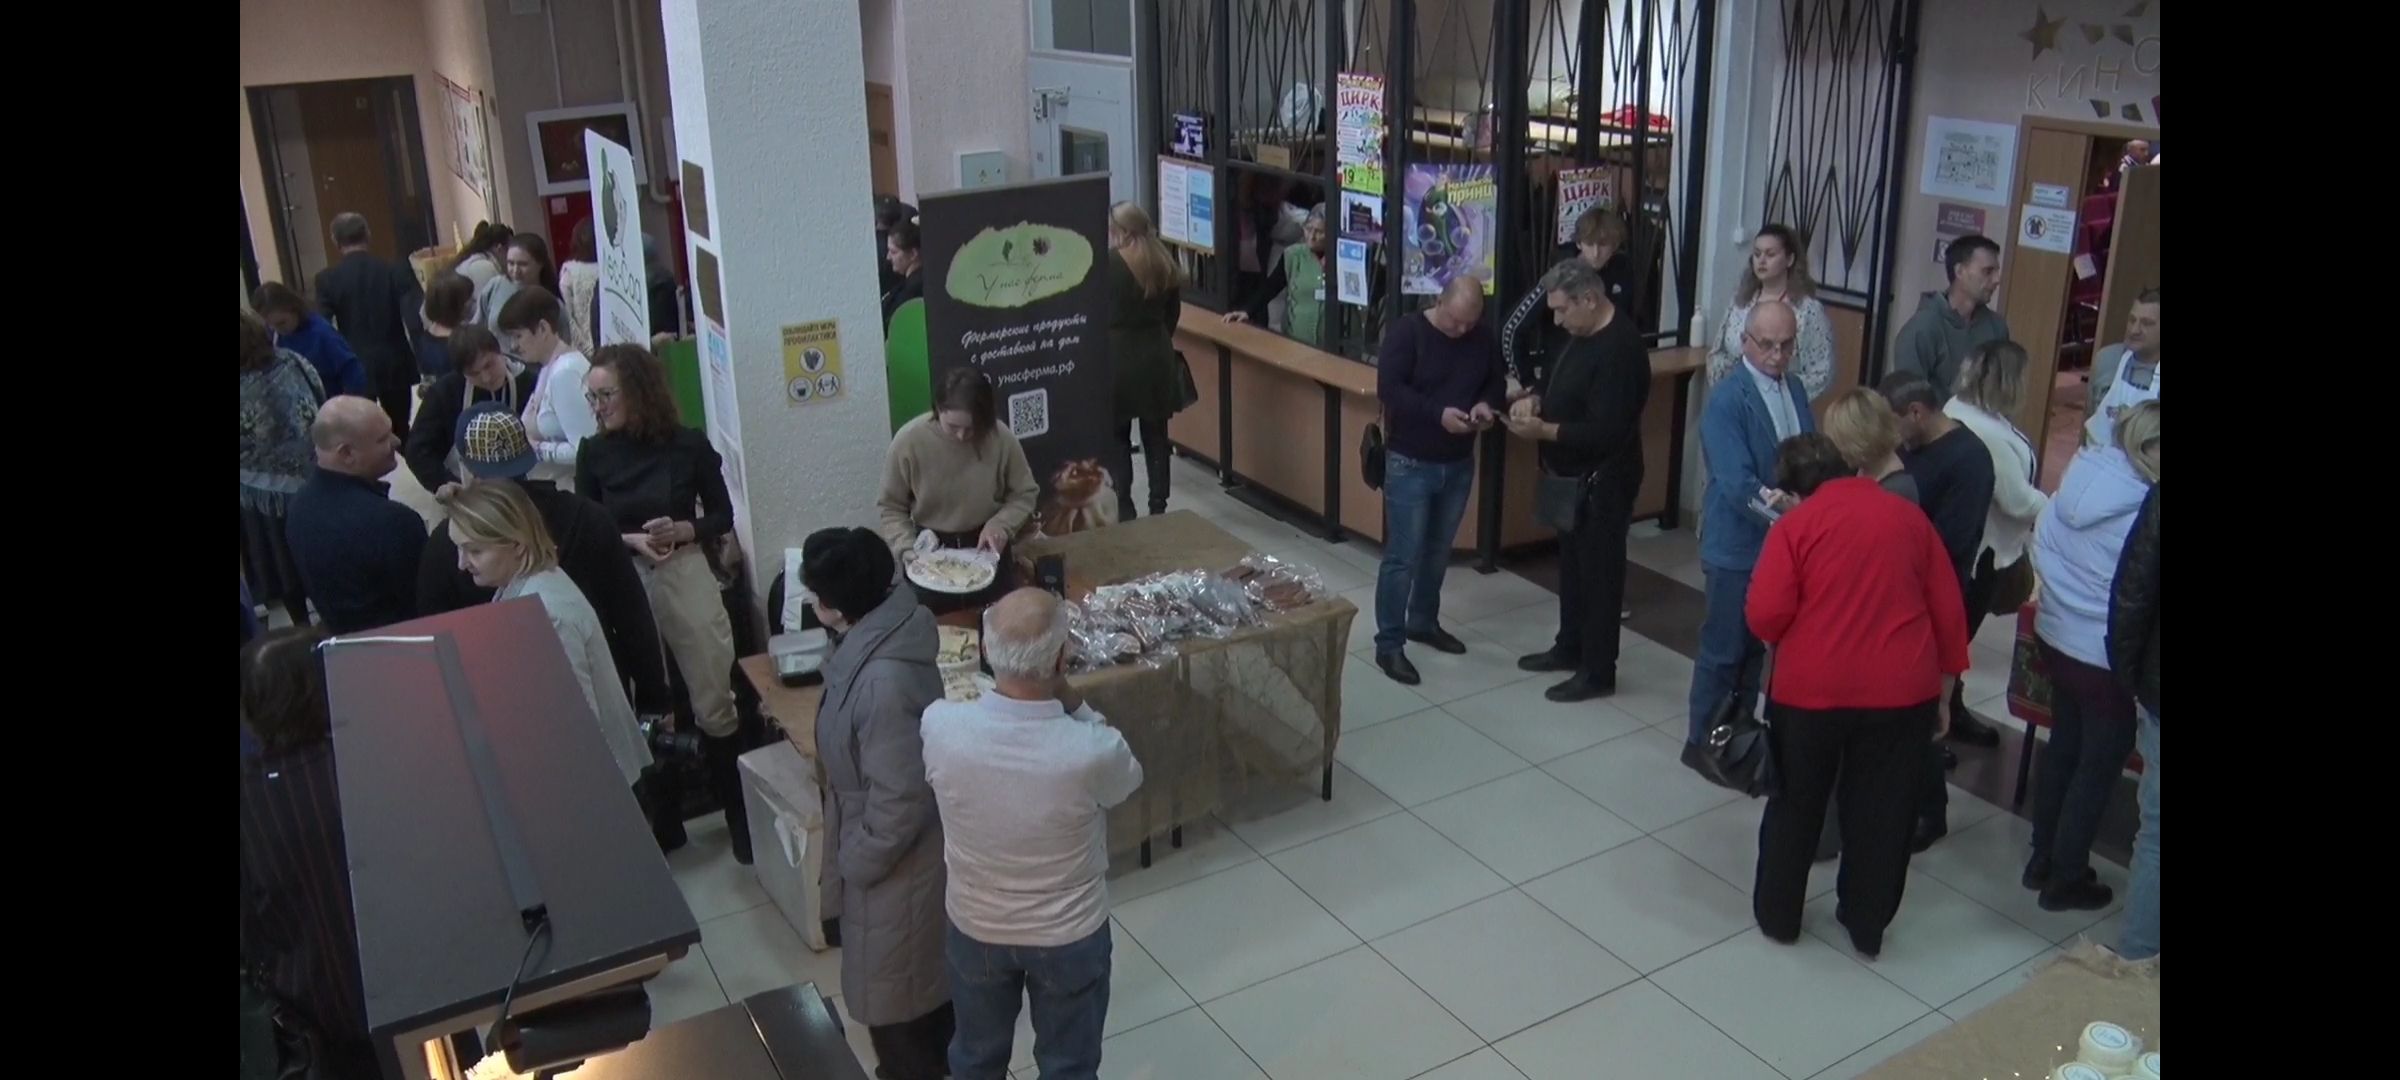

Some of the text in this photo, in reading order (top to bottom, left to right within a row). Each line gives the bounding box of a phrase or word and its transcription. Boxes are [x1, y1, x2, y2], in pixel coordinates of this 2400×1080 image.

[2025, 35, 2160, 111] КИНО
[1340, 91, 1379, 110] ЦИРК
[1563, 182, 1608, 203] ЦИРК
[961, 313, 1087, 348] Фермерские продукты
[970, 335, 1081, 365] с доставкой на дом
[998, 360, 1075, 388] унасферма.рф
